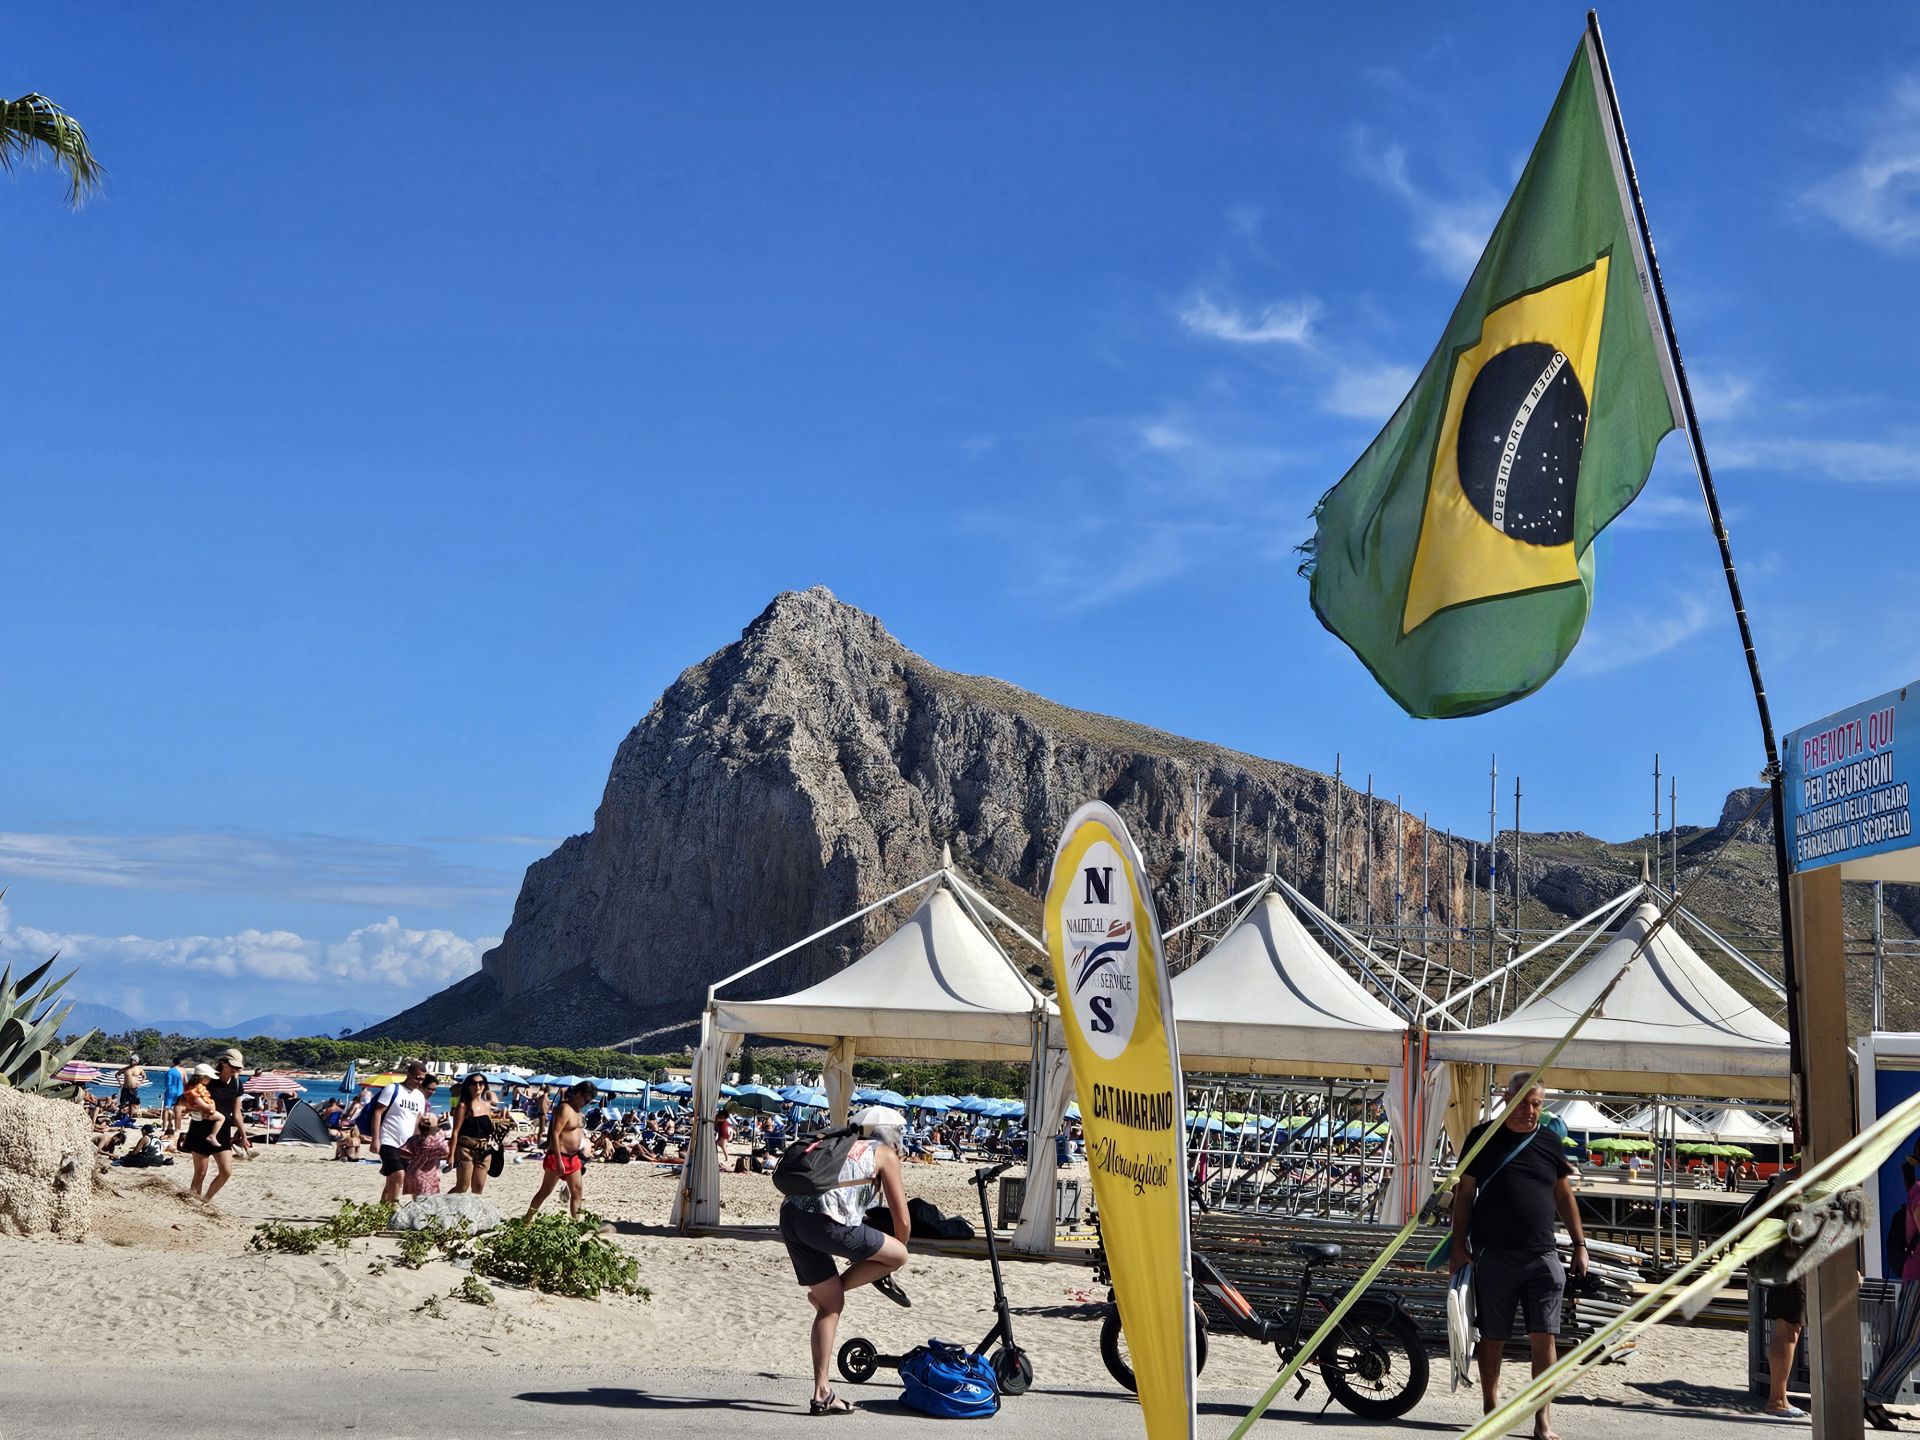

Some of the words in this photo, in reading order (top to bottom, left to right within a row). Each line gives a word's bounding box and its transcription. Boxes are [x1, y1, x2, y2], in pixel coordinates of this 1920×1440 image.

[1804, 719, 1863, 774] PRENOTA
[1868, 707, 1894, 752] QUI
[1804, 775, 1823, 809] PER
[1826, 751, 1893, 802] ESCURSIONI
[1796, 812, 1811, 837] ALLA
[1812, 803, 1843, 833] RISERVA
[1844, 794, 1869, 823] DELLO
[1870, 783, 1909, 815] ZINGARO
[1797, 838, 1803, 863] E
[1803, 826, 1849, 860] FARAGLIONI
[1850, 822, 1861, 848] DI
[1862, 809, 1910, 845] SCOPELLO
[1084, 866, 1114, 905] N
[1066, 917, 1106, 933] NAUTICAL
[1101, 973, 1132, 991] SERVICE
[1089, 995, 1115, 1033] S
[1093, 1083, 1173, 1131] CATAMARANO
